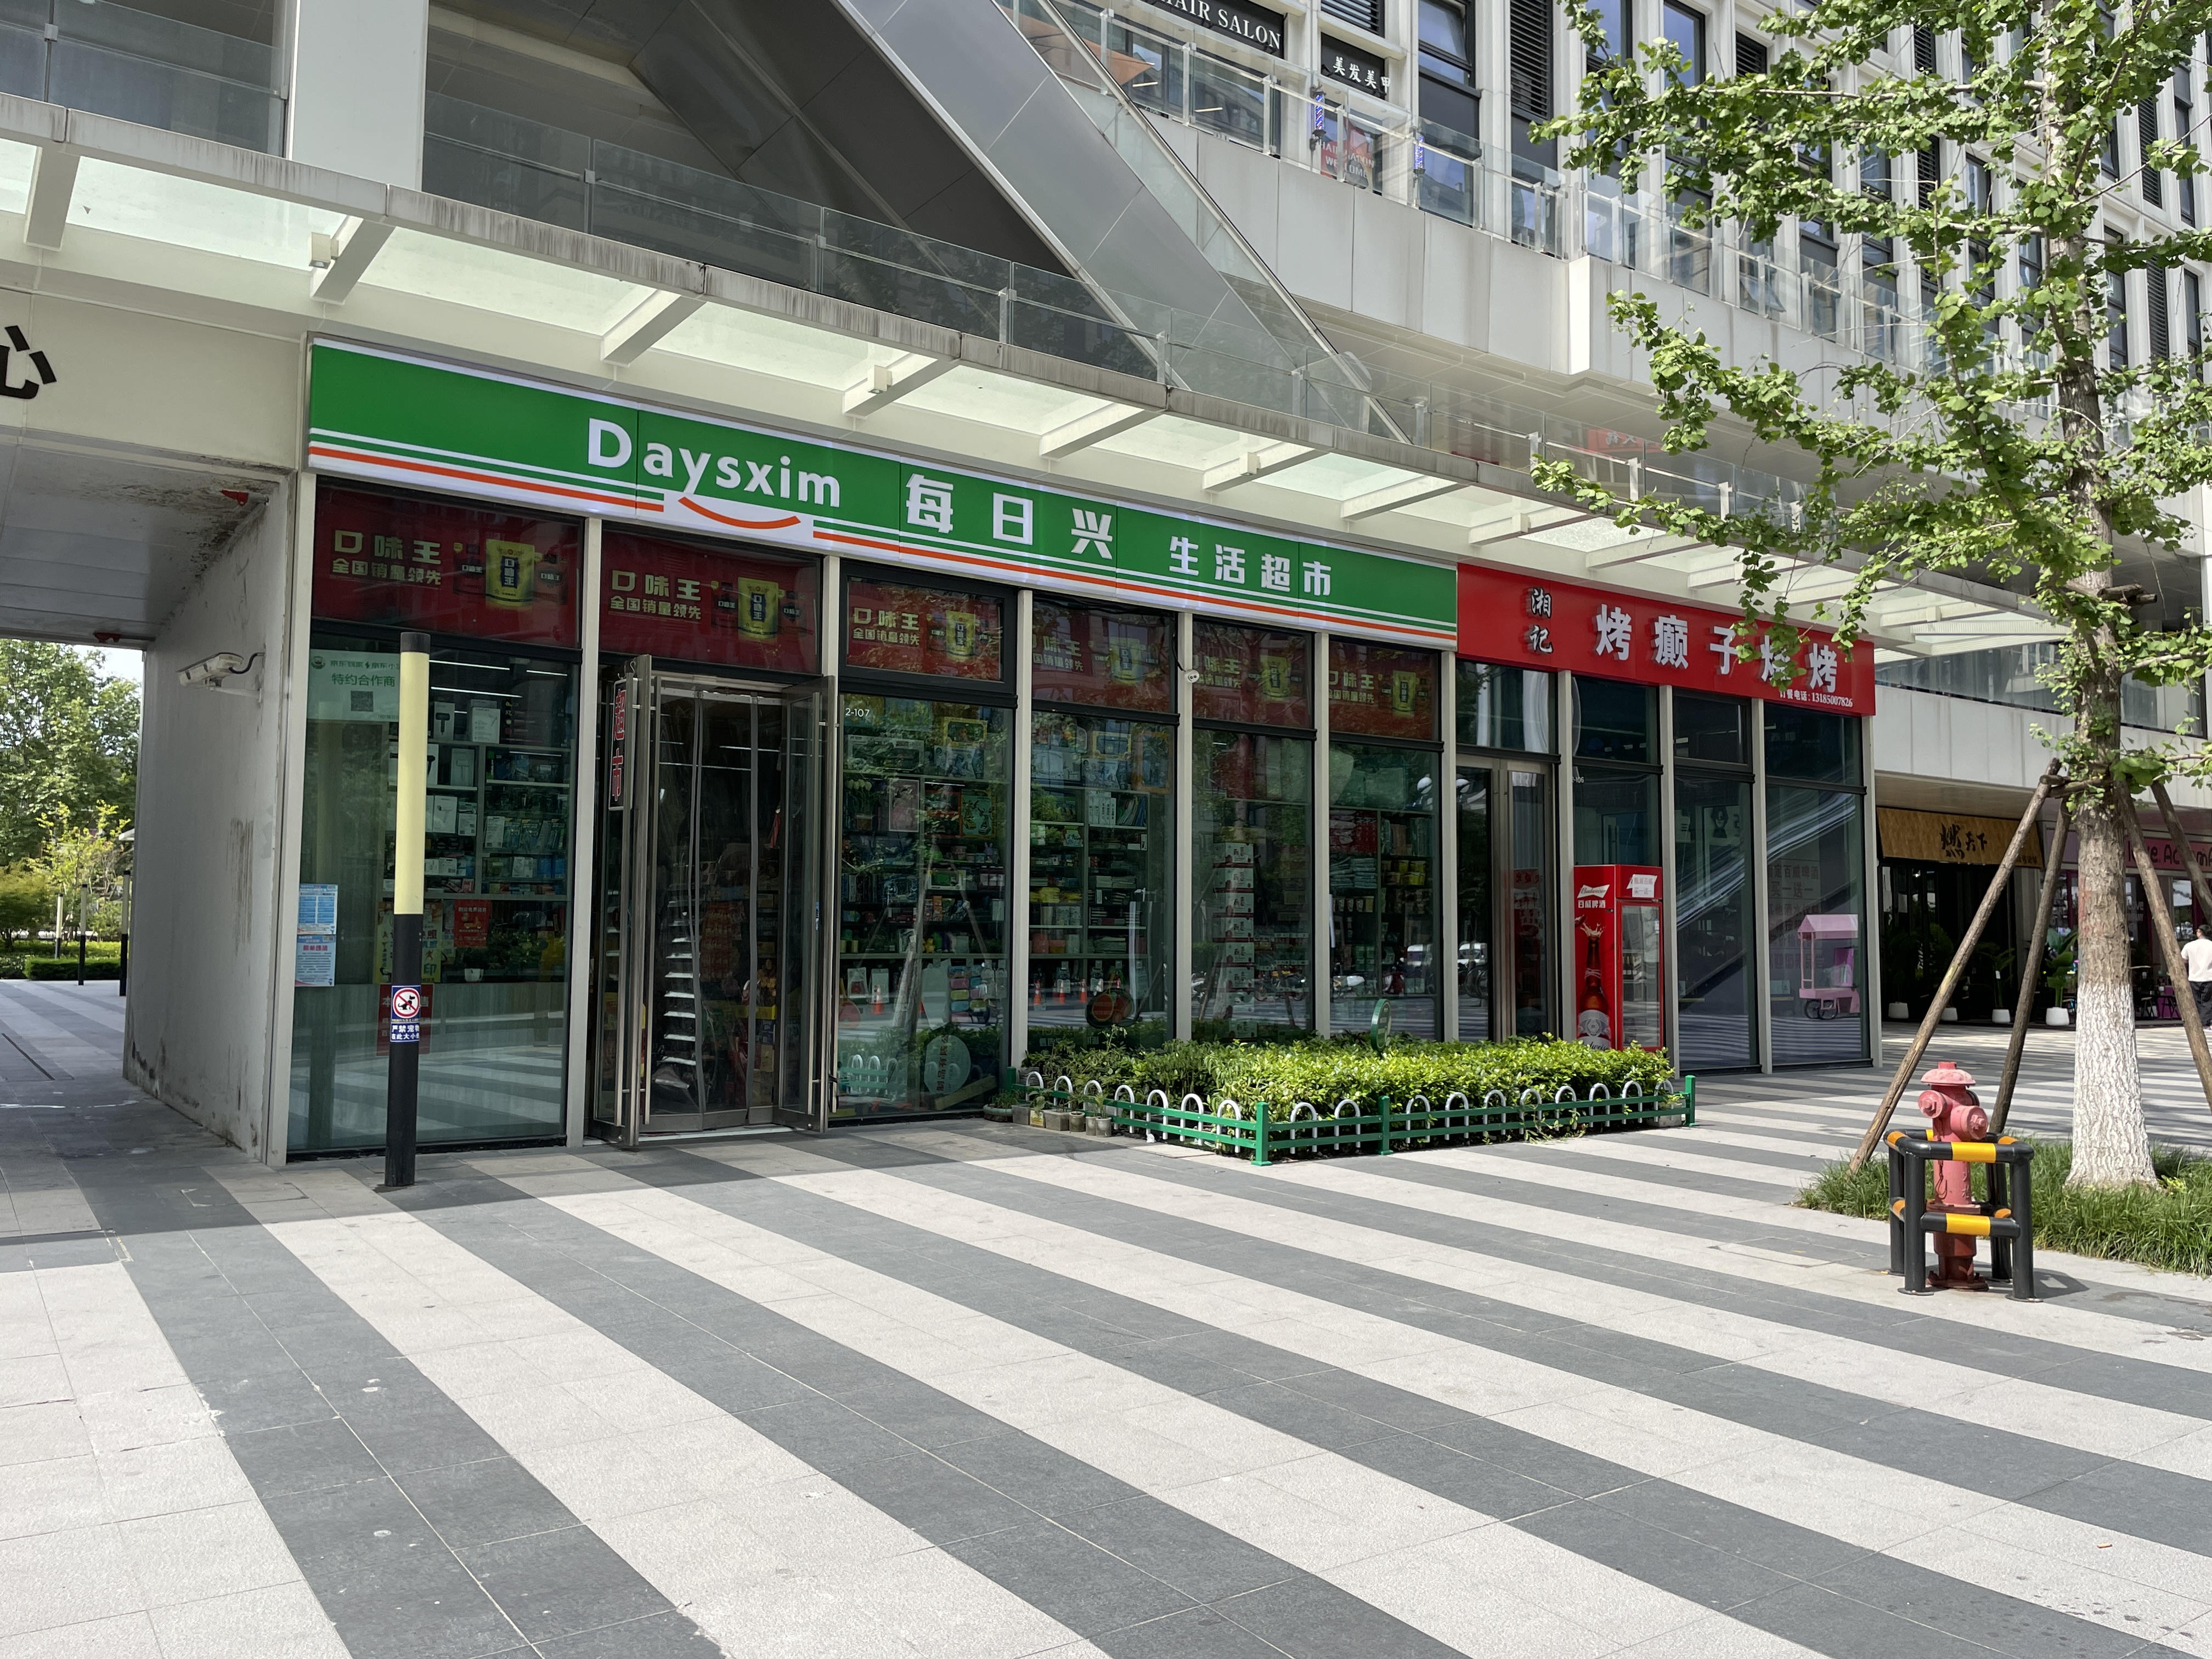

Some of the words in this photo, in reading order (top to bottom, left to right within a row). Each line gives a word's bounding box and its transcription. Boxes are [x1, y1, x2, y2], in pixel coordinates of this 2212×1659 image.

[1218, 9, 1281, 50] SALON
[1333, 56, 1391, 93] 美发美甲
[588, 417, 840, 508] Daysxim
[334, 529, 442, 565] 口味王
[905, 472, 1113, 560] 每日兴
[1169, 535, 1331, 597] 生活超市
[332, 558, 442, 586] 全国销量领先
[611, 570, 702, 601] 口味王
[610, 595, 702, 620] 全国销量领先
[854, 607, 919, 631] 口味王
[1529, 586, 1554, 654] 湘记
[853, 628, 920, 646] 全国销量领先
[1032, 634, 1081, 657] 味王
[331, 672, 396, 687] 特约合作商
[845, 707, 870, 717] 2-107
[1770, 881, 1814, 898] 买一送一
